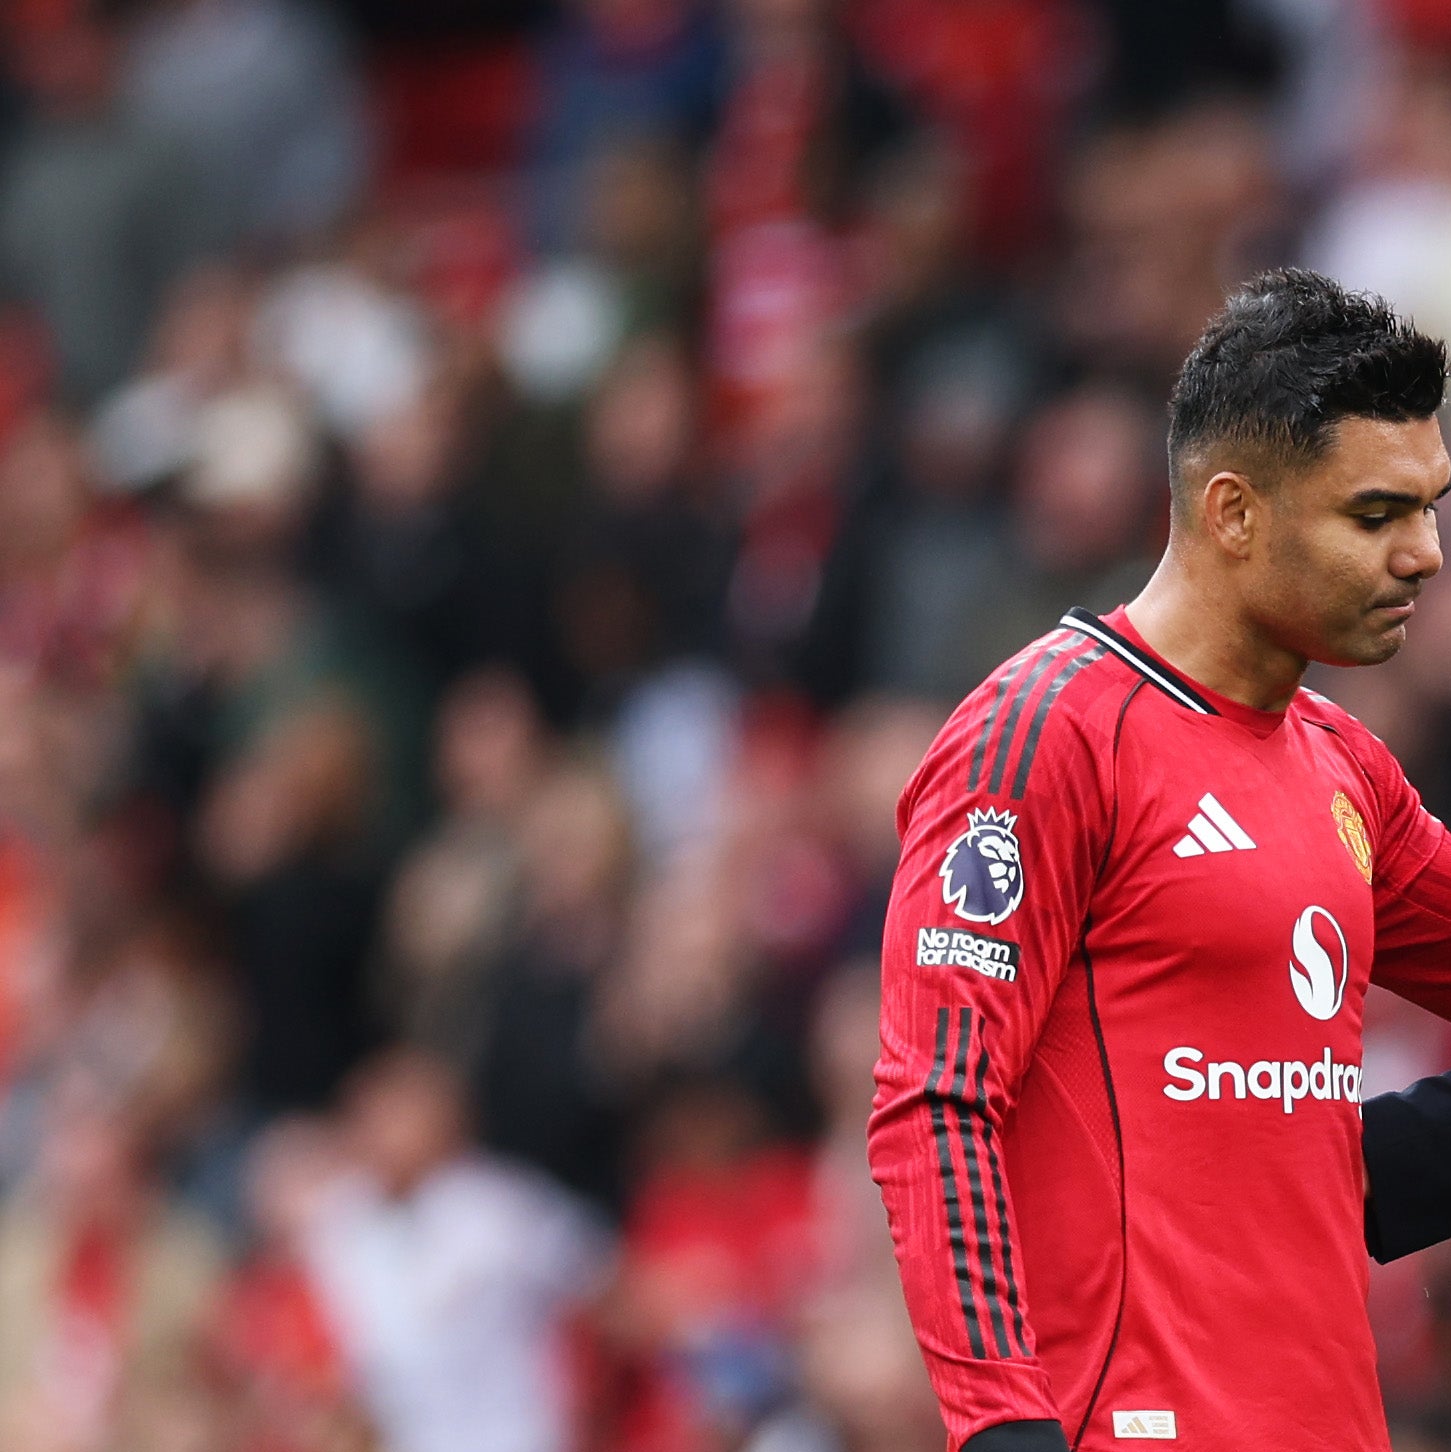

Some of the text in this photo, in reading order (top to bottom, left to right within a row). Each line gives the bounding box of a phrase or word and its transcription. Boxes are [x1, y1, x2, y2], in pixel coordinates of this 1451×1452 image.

[917, 945, 947, 966] for
[918, 928, 1011, 962] No room
[1163, 1047, 1363, 1120] Snapdra
